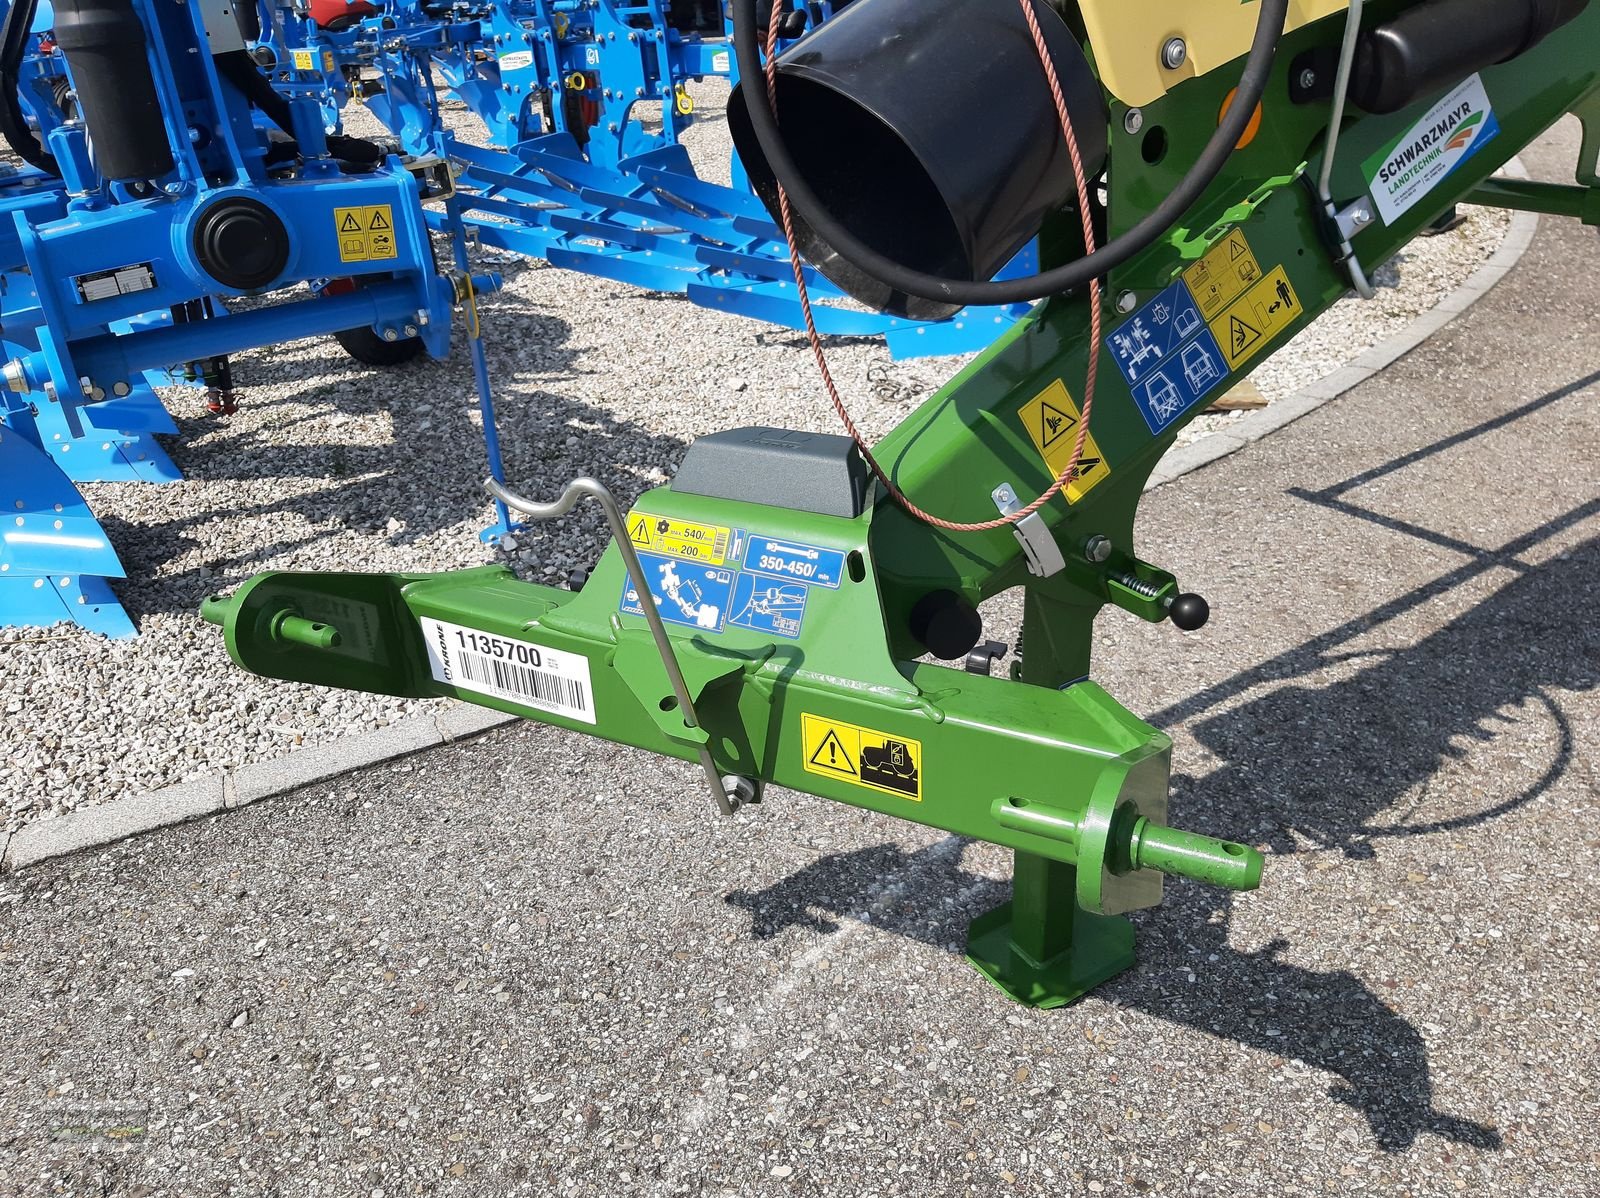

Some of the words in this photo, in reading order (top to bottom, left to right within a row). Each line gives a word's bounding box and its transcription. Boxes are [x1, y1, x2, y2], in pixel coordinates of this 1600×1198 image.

[1379, 101, 1472, 184] SCHWARZMAYR
[1388, 146, 1442, 195] LANDTECHNIK
[680, 545, 699, 557] 200
[436, 623, 452, 668] KRONE
[456, 630, 541, 667] 1135700
